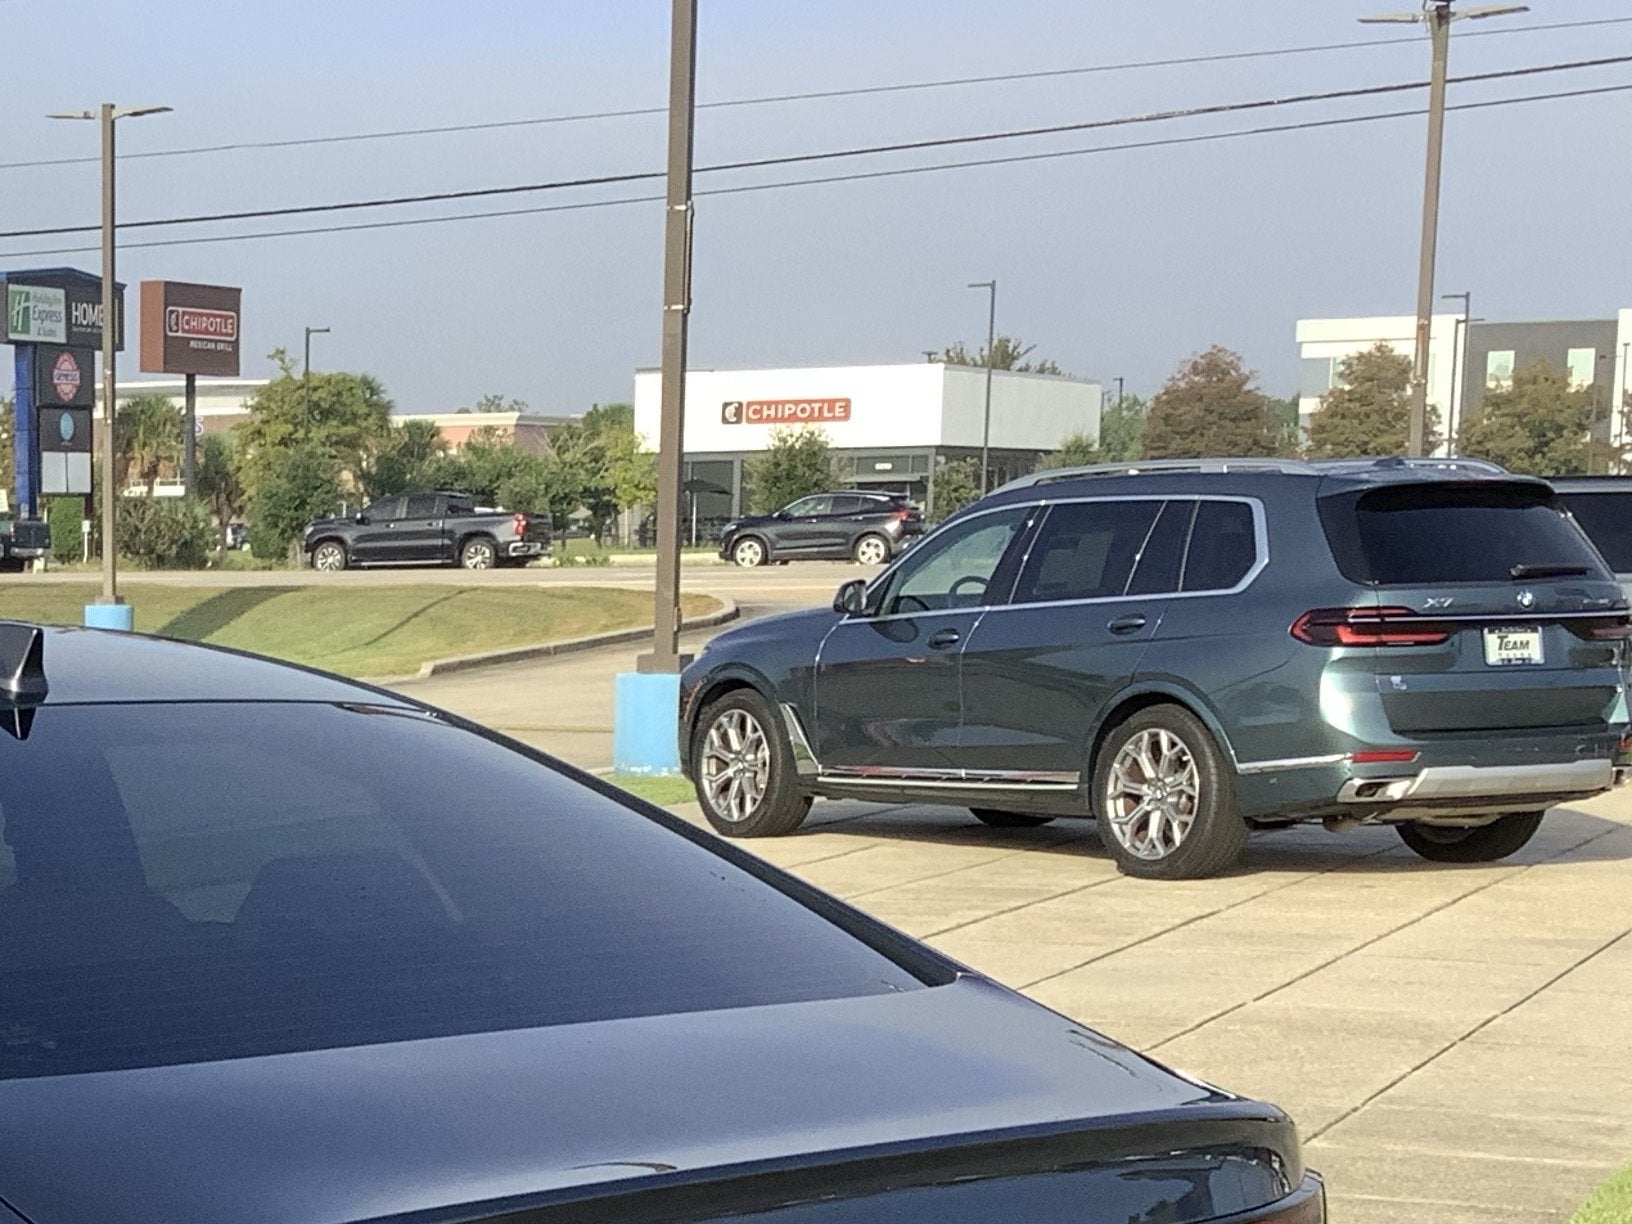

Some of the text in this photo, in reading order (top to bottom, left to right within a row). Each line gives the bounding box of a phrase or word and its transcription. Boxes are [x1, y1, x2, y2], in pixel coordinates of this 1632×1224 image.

[32, 304, 62, 325] Express
[183, 316, 234, 334] CHIPOTLE
[748, 401, 847, 420] CHIPOTLE
[1423, 597, 1455, 608] X7
